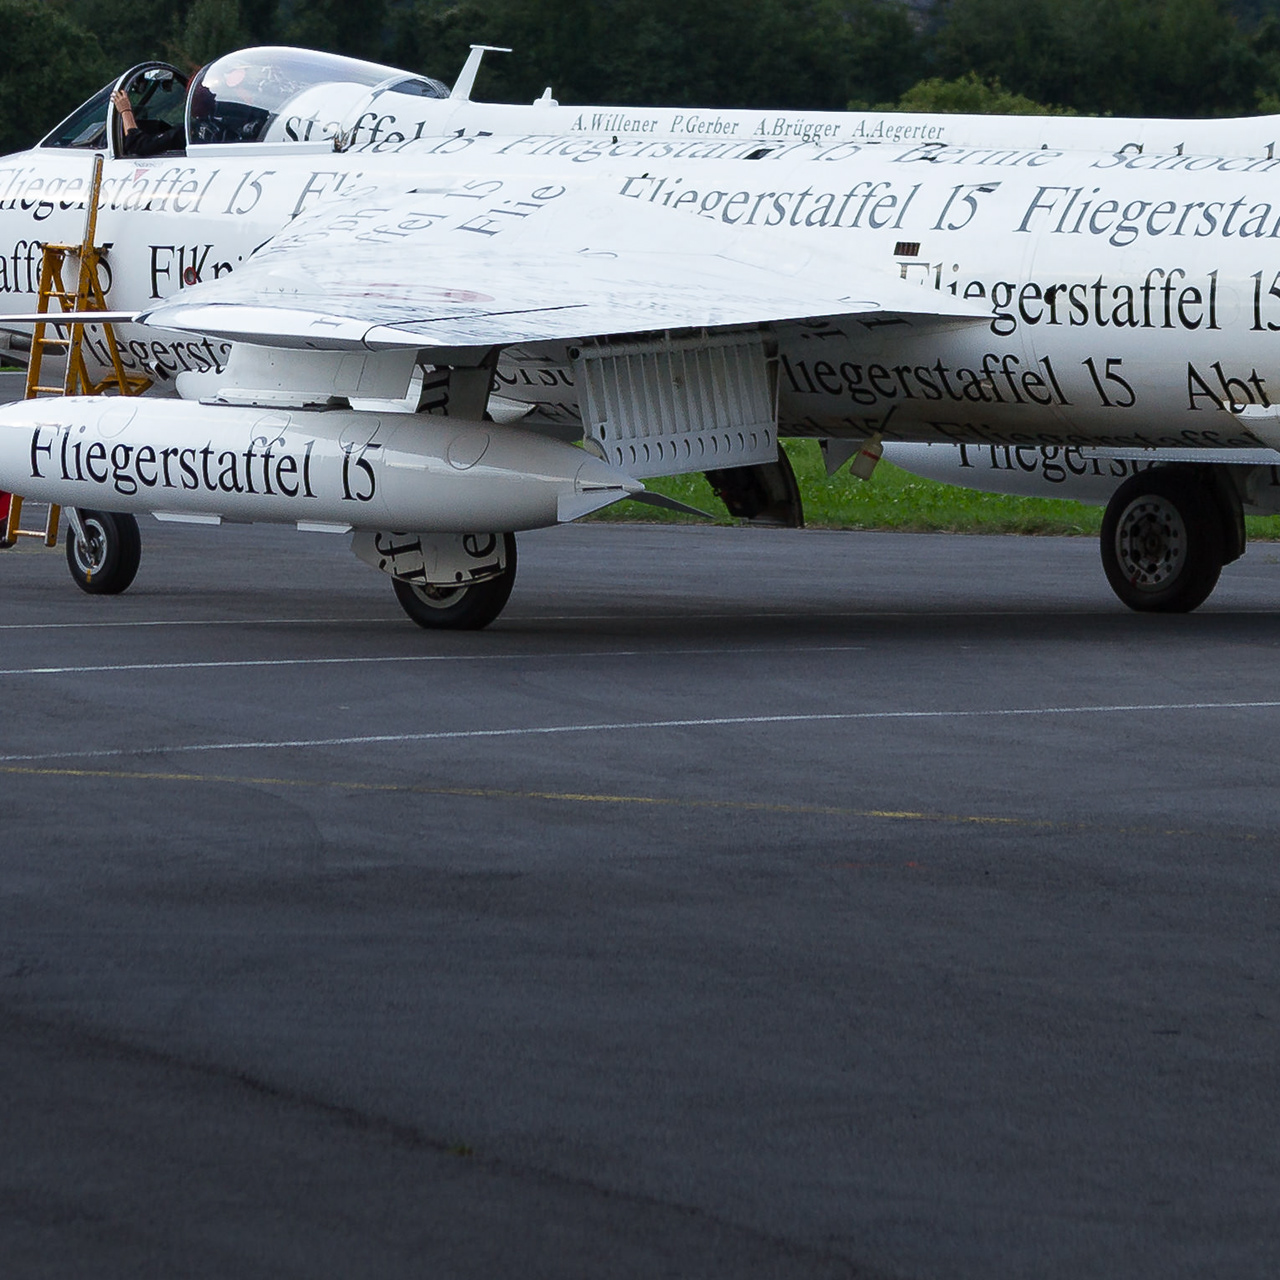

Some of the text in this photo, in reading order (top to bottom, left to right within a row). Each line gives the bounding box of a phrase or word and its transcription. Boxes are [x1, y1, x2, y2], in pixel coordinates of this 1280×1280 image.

[571, 114, 946, 142] A.Willener P.Gerber A.Brügger A.Aegerter
[222, 169, 277, 215] 15
[618, 172, 924, 231] Fliegerstaffel
[929, 183, 1000, 232] 15
[1081, 356, 1137, 408] 15
[1186, 360, 1272, 414] Abt
[29, 422, 384, 502] Fliegerstaffel 15
